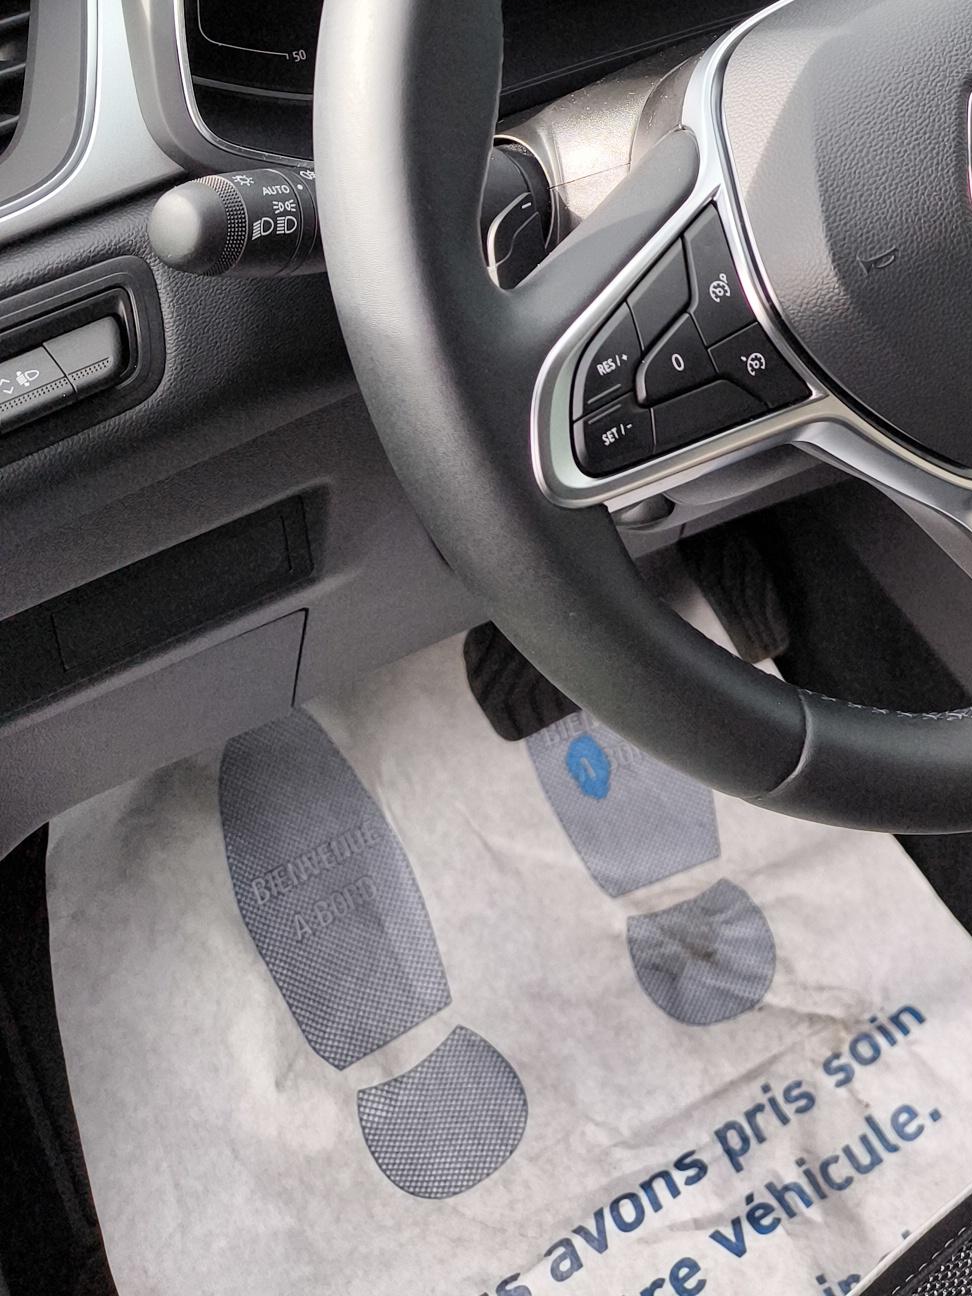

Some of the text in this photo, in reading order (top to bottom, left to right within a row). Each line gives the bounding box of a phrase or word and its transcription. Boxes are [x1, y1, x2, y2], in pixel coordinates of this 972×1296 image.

[292, 50, 307, 63] 50
[262, 184, 290, 196] AUTO
[543, 1149, 708, 1283] avons
[714, 1081, 817, 1173] pris
[822, 1004, 926, 1089] soin
[709, 1103, 942, 1259] véhicule.
